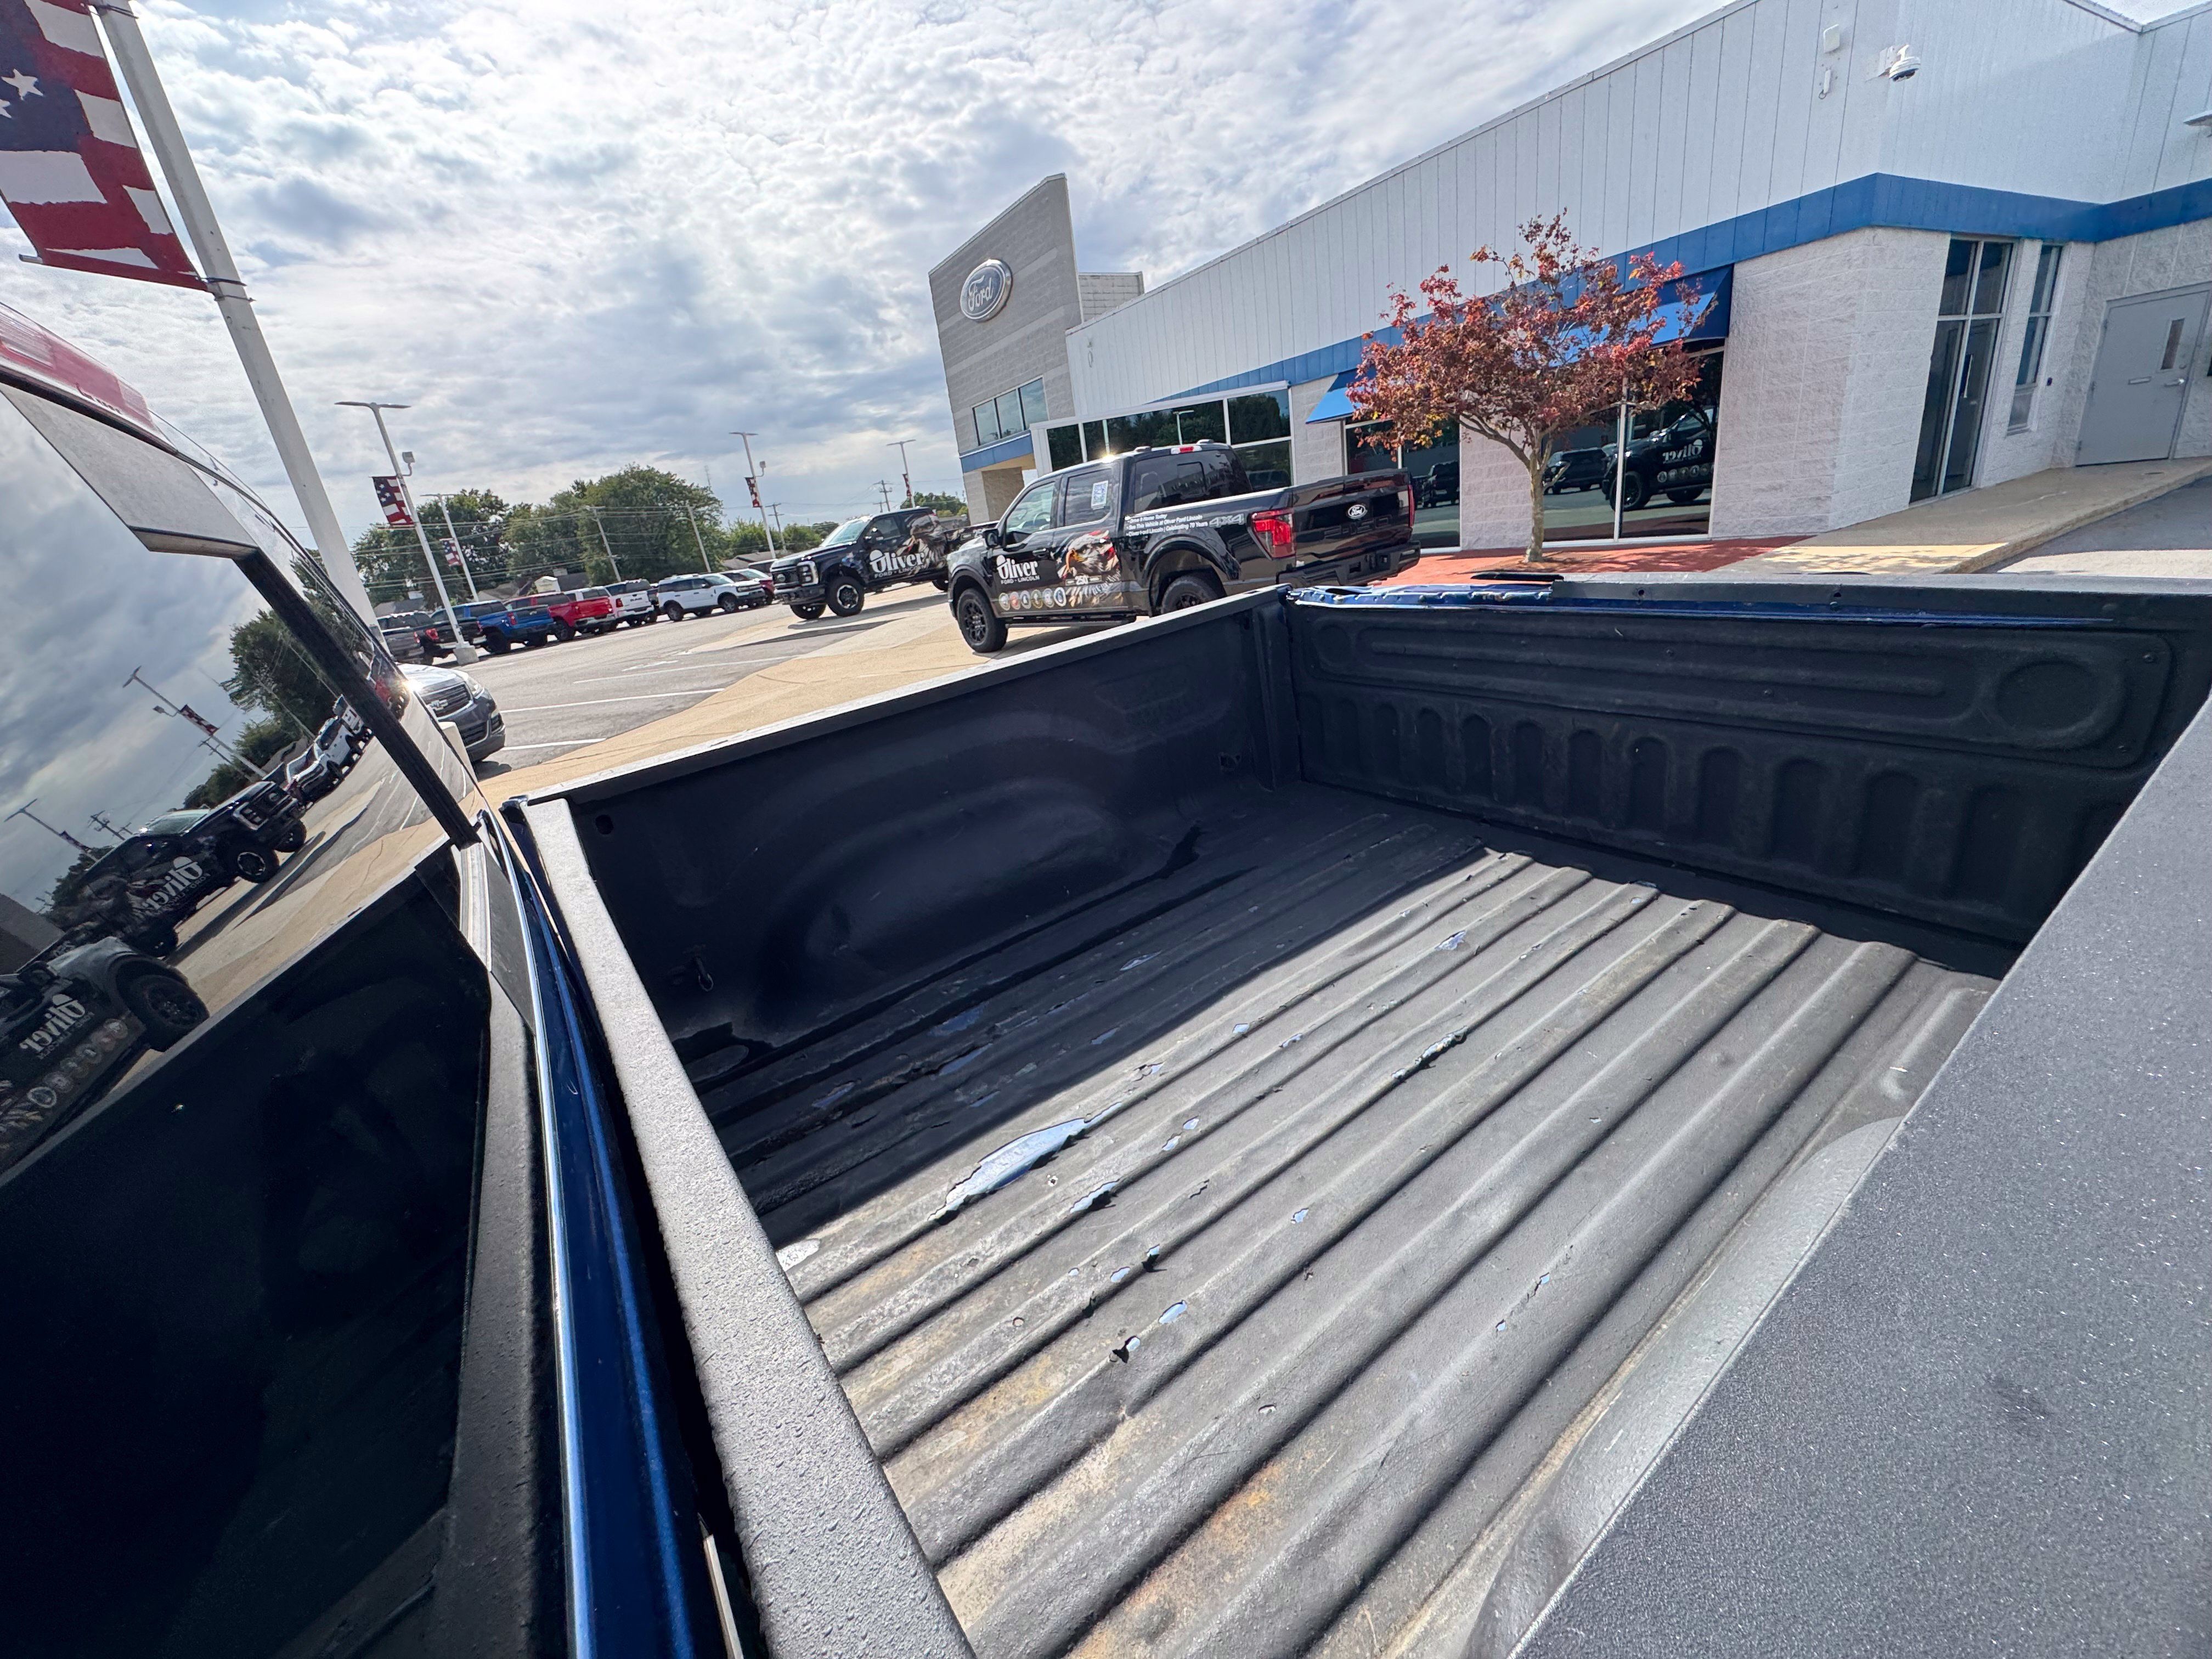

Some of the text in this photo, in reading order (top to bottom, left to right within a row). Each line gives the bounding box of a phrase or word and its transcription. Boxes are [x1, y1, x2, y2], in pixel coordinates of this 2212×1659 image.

[968, 275, 994, 312] Ford
[870, 550, 926, 573] Oliver
[996, 555, 1038, 580] Oliver
[1017, 575, 1040, 583] LINCOLN
